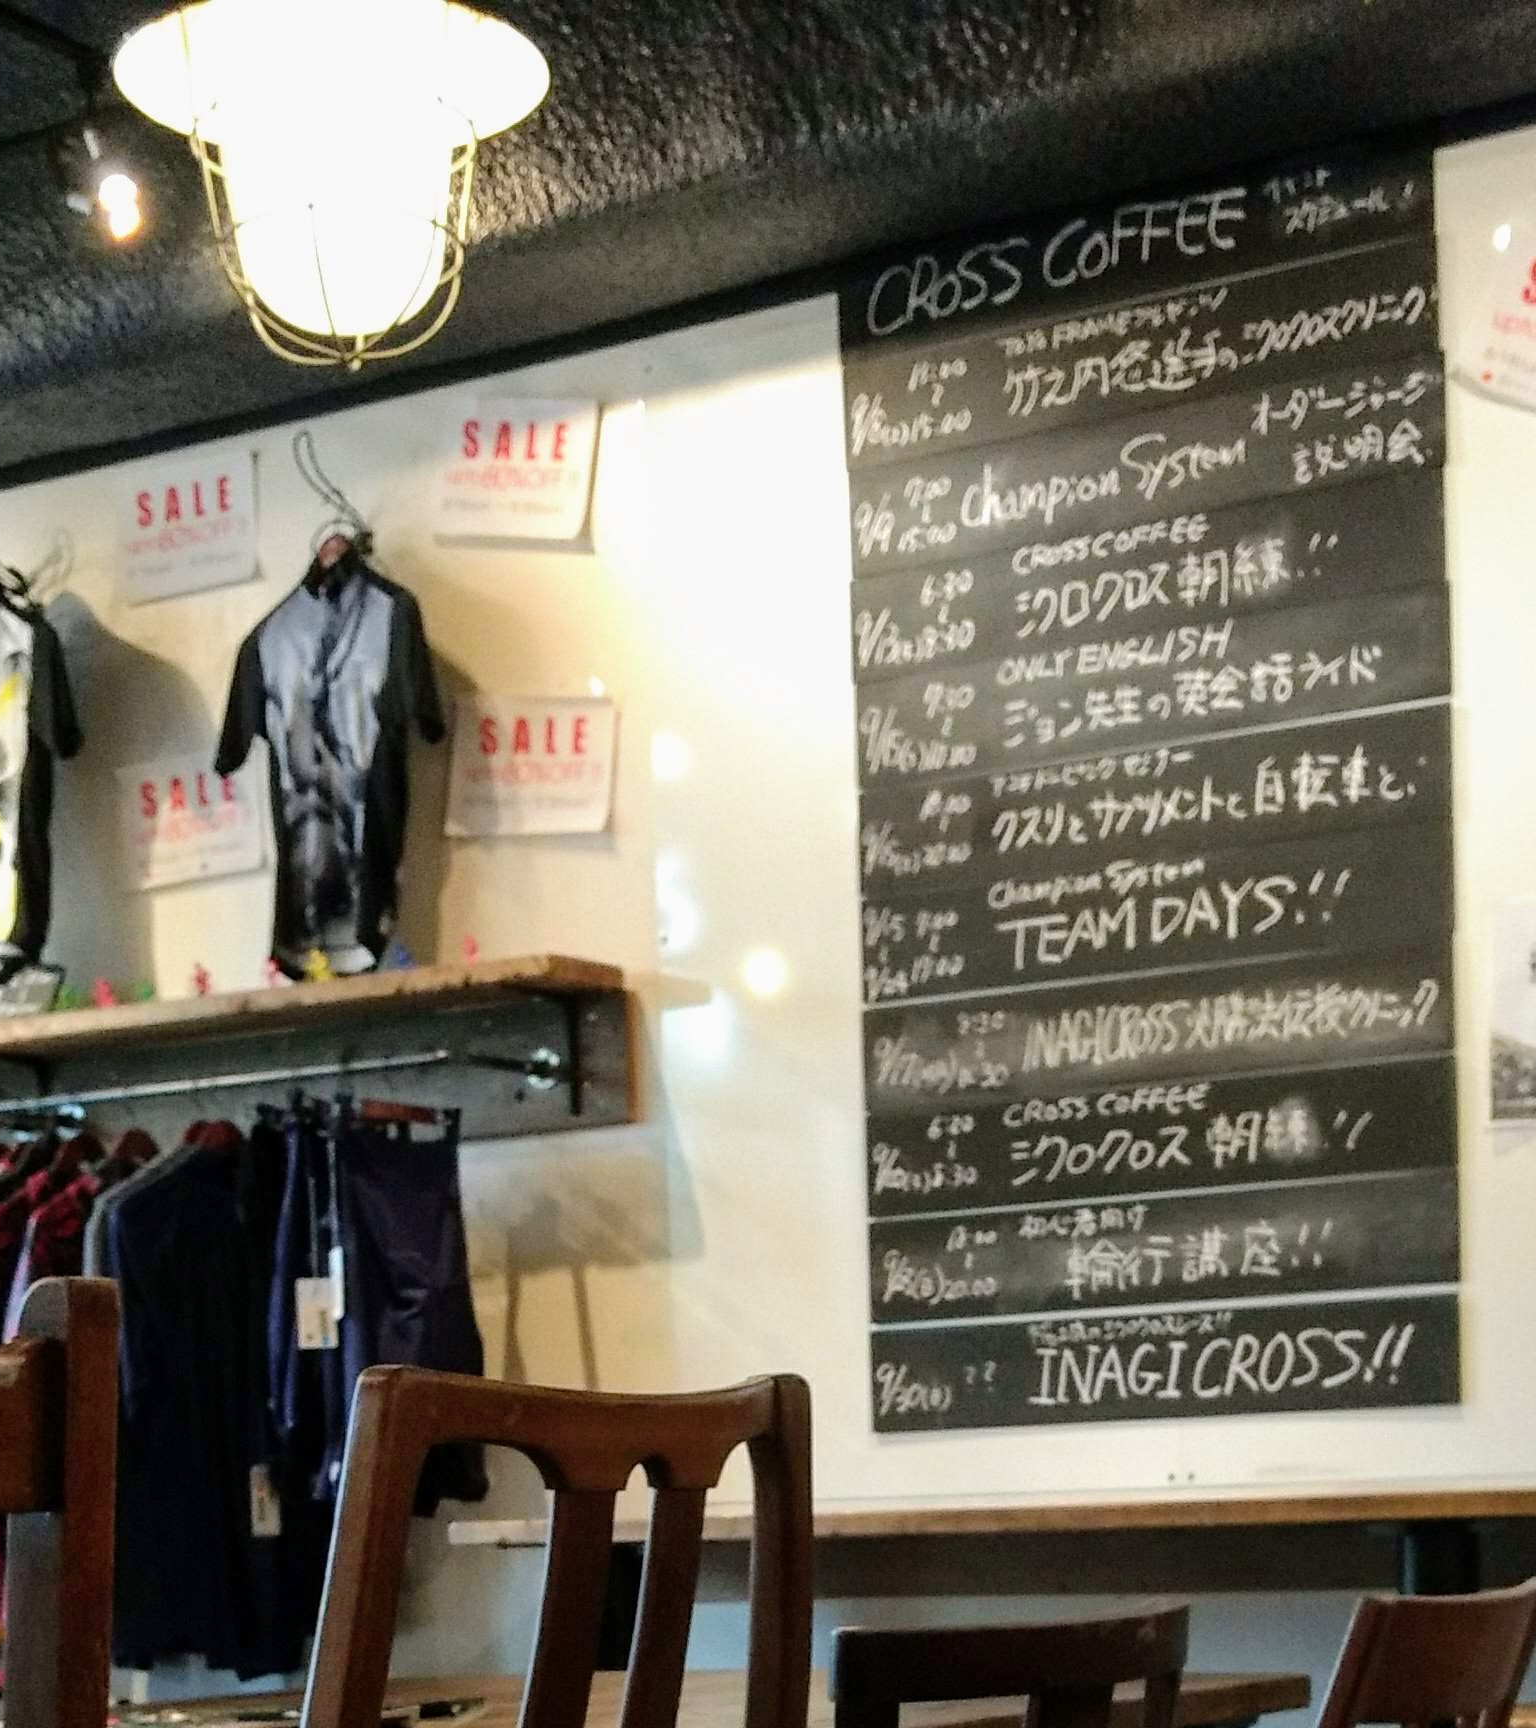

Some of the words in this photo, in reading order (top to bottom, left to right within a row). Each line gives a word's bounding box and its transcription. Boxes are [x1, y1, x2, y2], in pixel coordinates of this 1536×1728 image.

[867, 237, 1031, 336] CROSS
[1042, 187, 1247, 288] COFFEE
[463, 419, 570, 461] SALE
[137, 475, 231, 527] SALE
[1091, 513, 1210, 558] COFFEE
[996, 650, 1073, 685] ONLY
[1076, 617, 1234, 675] ENGLISH
[479, 717, 588, 755] SALE
[140, 772, 234, 818] SALE
[995, 896, 1137, 970] TEAM
[1002, 1099, 1091, 1128] CROSS
[1097, 1081, 1213, 1117] COFFEE
